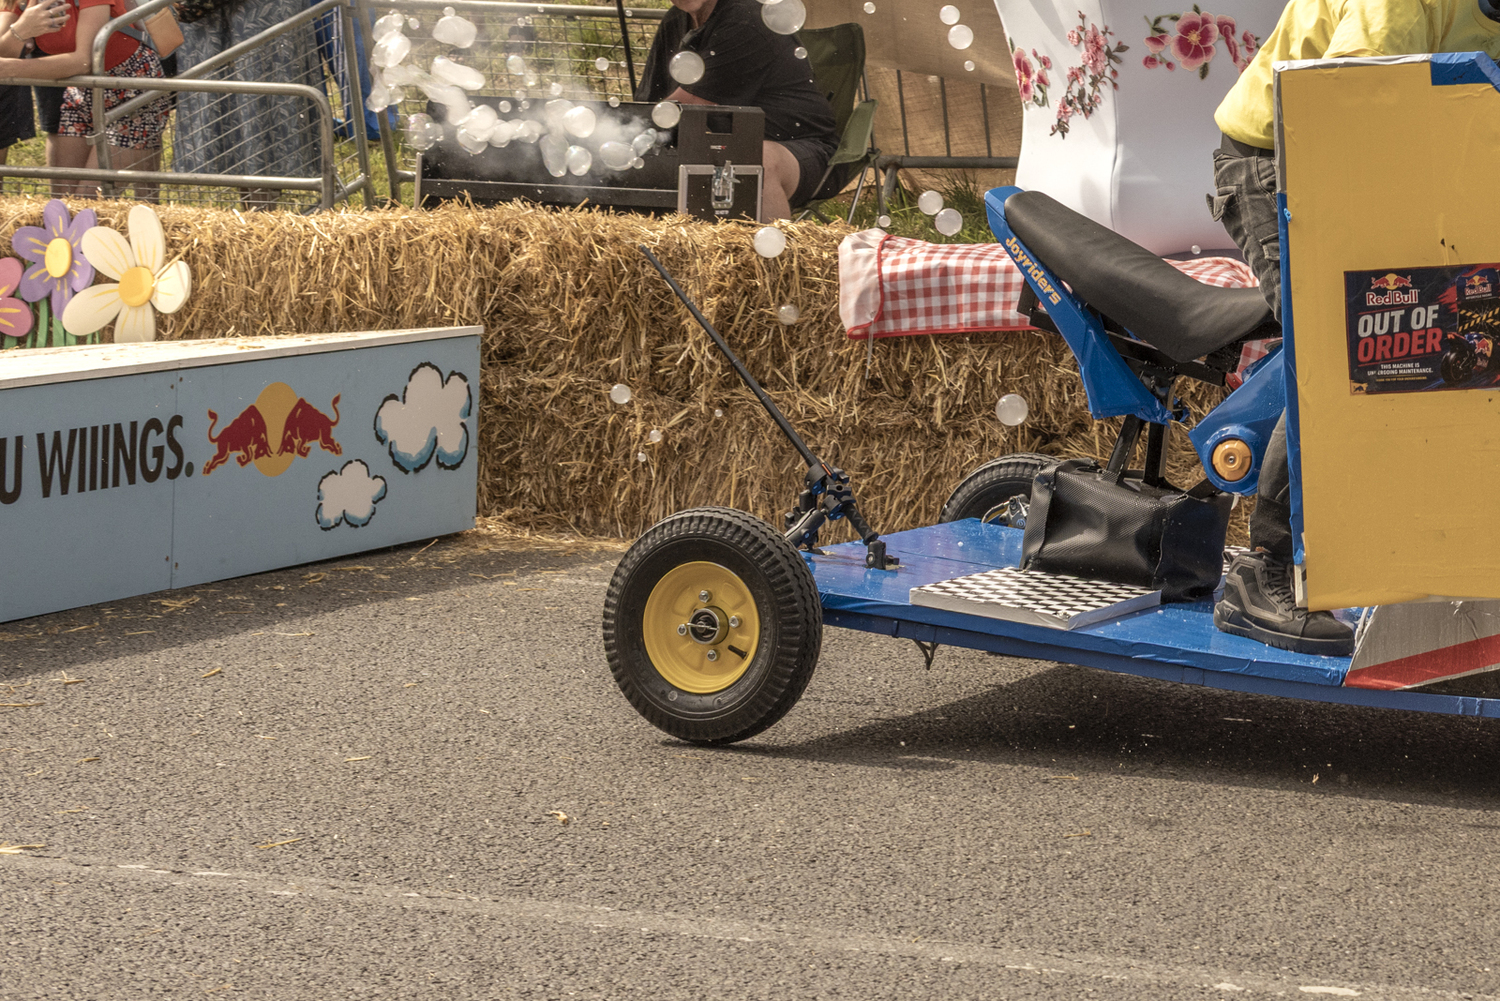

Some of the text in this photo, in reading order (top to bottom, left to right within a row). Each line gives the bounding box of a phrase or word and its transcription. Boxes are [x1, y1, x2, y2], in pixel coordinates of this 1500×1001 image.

[1006, 236, 1062, 306] Joyriders
[1366, 289, 1419, 306] Red Bull
[1358, 304, 1440, 338] OUT OF
[1357, 327, 1443, 363] ORDER
[1398, 367, 1434, 375] MAINTENANCE.
[36, 414, 195, 499] WIIINGS.
